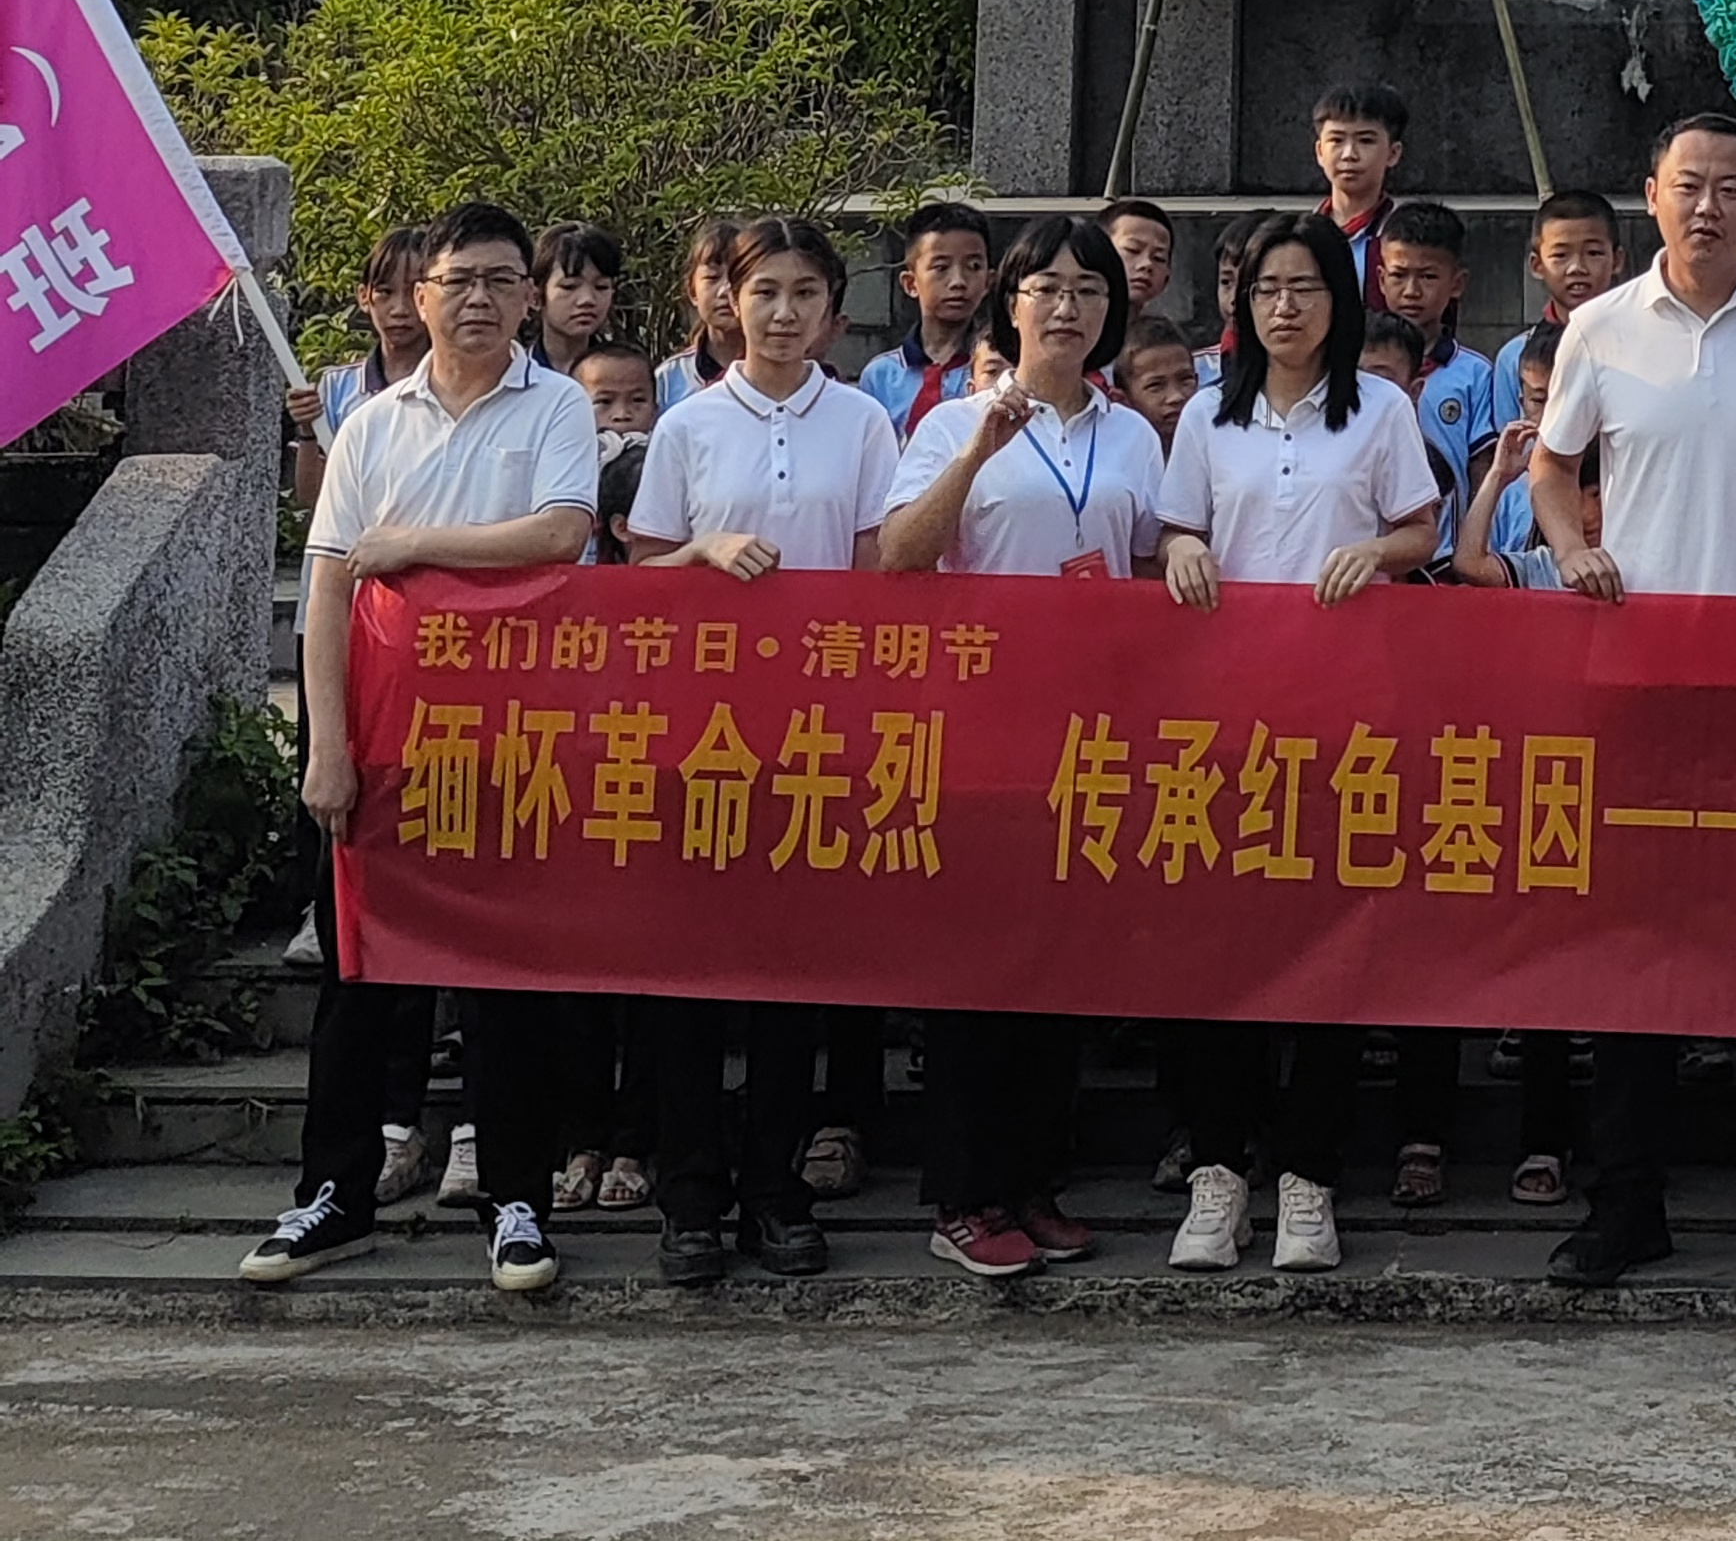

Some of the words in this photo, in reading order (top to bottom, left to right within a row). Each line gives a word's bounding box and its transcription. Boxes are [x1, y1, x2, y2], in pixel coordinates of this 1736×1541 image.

[0, 197, 134, 355] 班
[397, 696, 944, 879] 缅怀革命先烈
